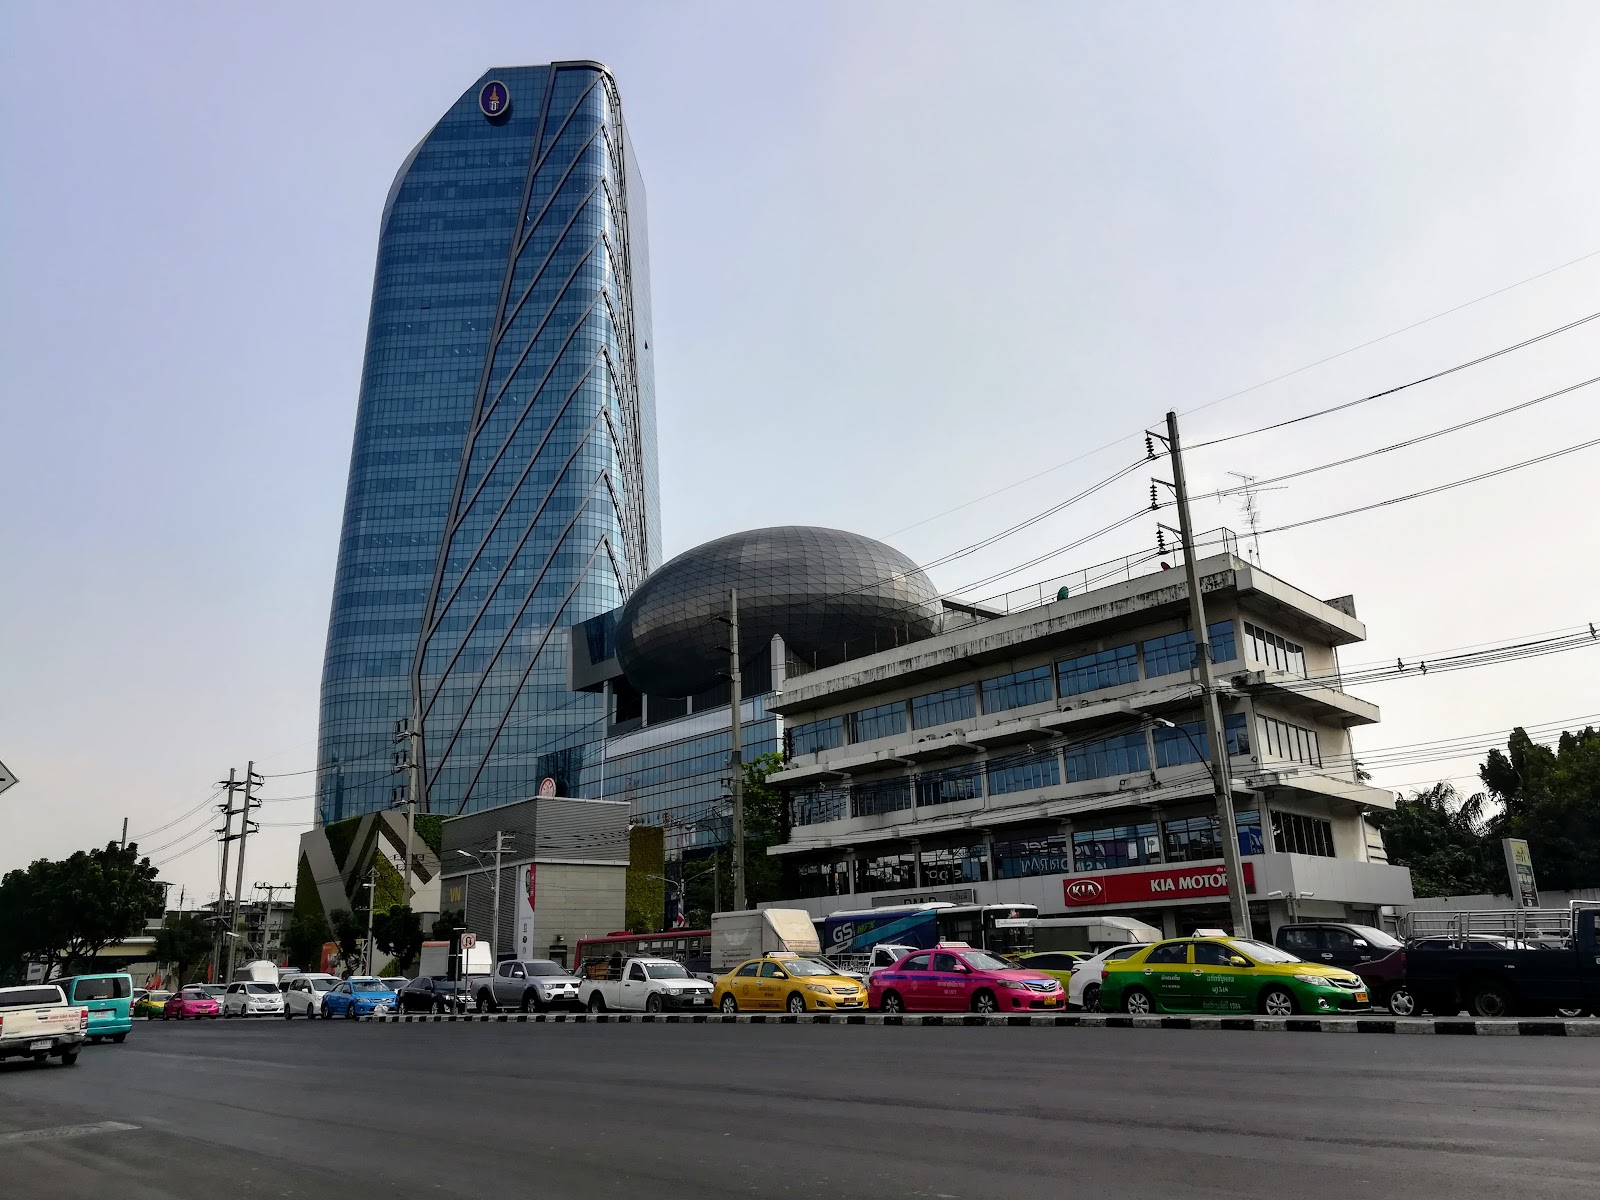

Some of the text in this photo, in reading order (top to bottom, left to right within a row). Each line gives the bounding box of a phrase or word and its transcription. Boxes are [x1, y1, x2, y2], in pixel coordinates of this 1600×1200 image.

[1072, 884, 1097, 897] KIA
[1150, 873, 1229, 892] KIA MOTOR
[833, 922, 853, 943] GS
